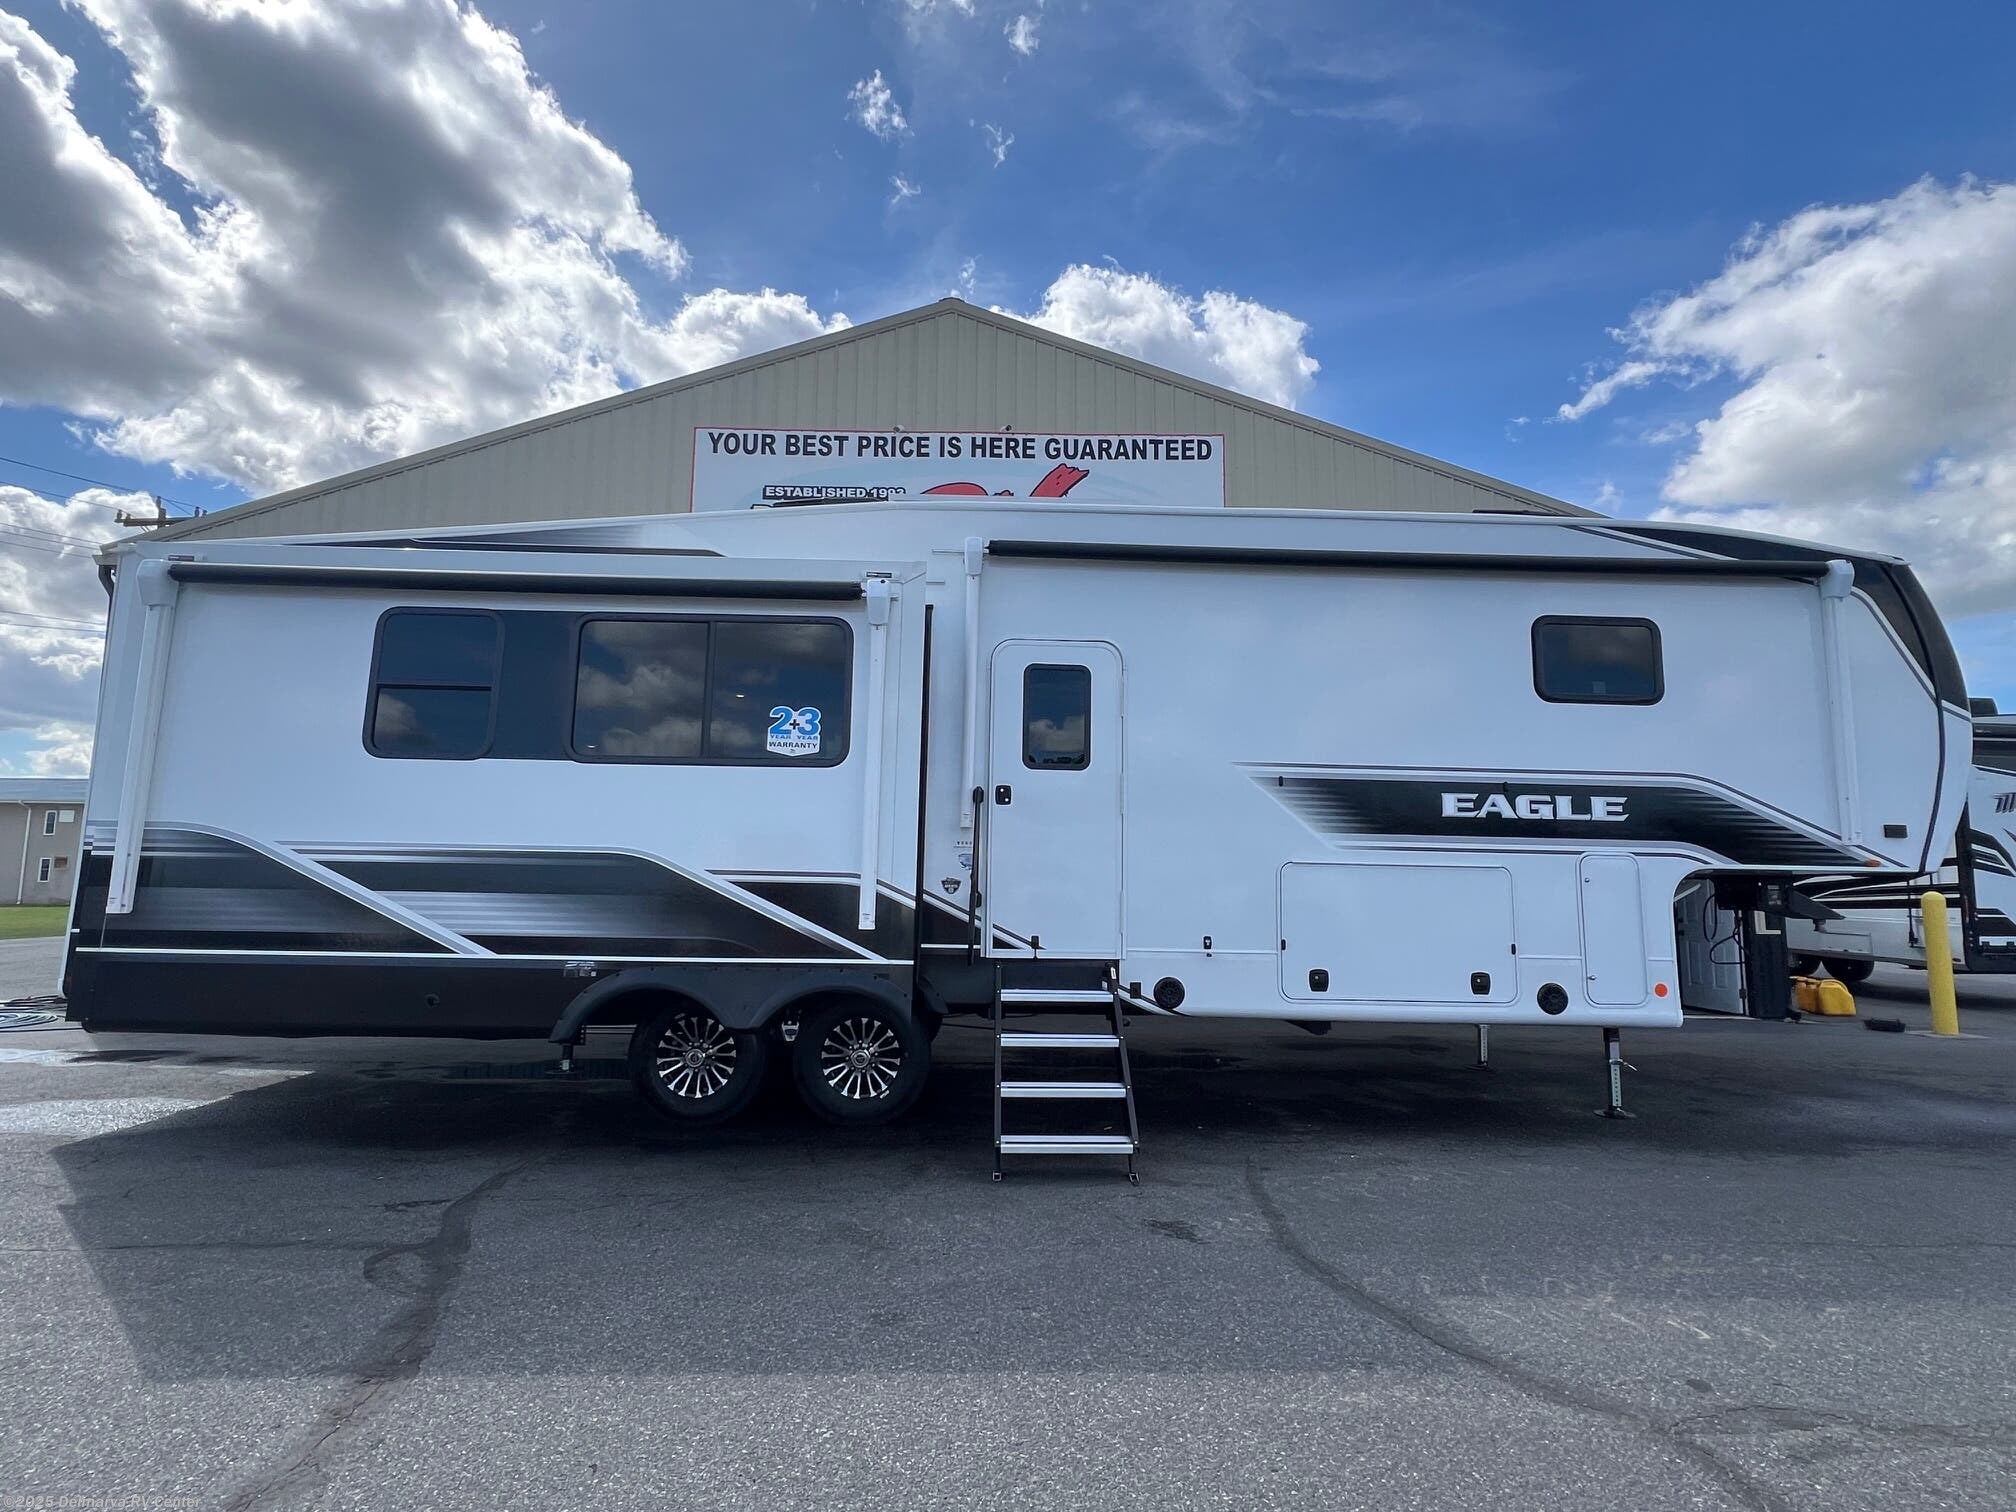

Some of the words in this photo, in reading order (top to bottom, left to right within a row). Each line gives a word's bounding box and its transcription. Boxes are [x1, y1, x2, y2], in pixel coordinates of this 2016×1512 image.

[708, 432, 776, 455] YOUR
[785, 434, 848, 456] BEST
[857, 436, 930, 458] PRICE
[940, 437, 962, 458] IS
[971, 437, 1035, 459] HERE
[1044, 438, 1212, 460] GUARANTEED
[765, 486, 867, 498] ESTABLISHED
[769, 741, 817, 749] WARRANTY
[1441, 792, 1629, 822] EAGLE
